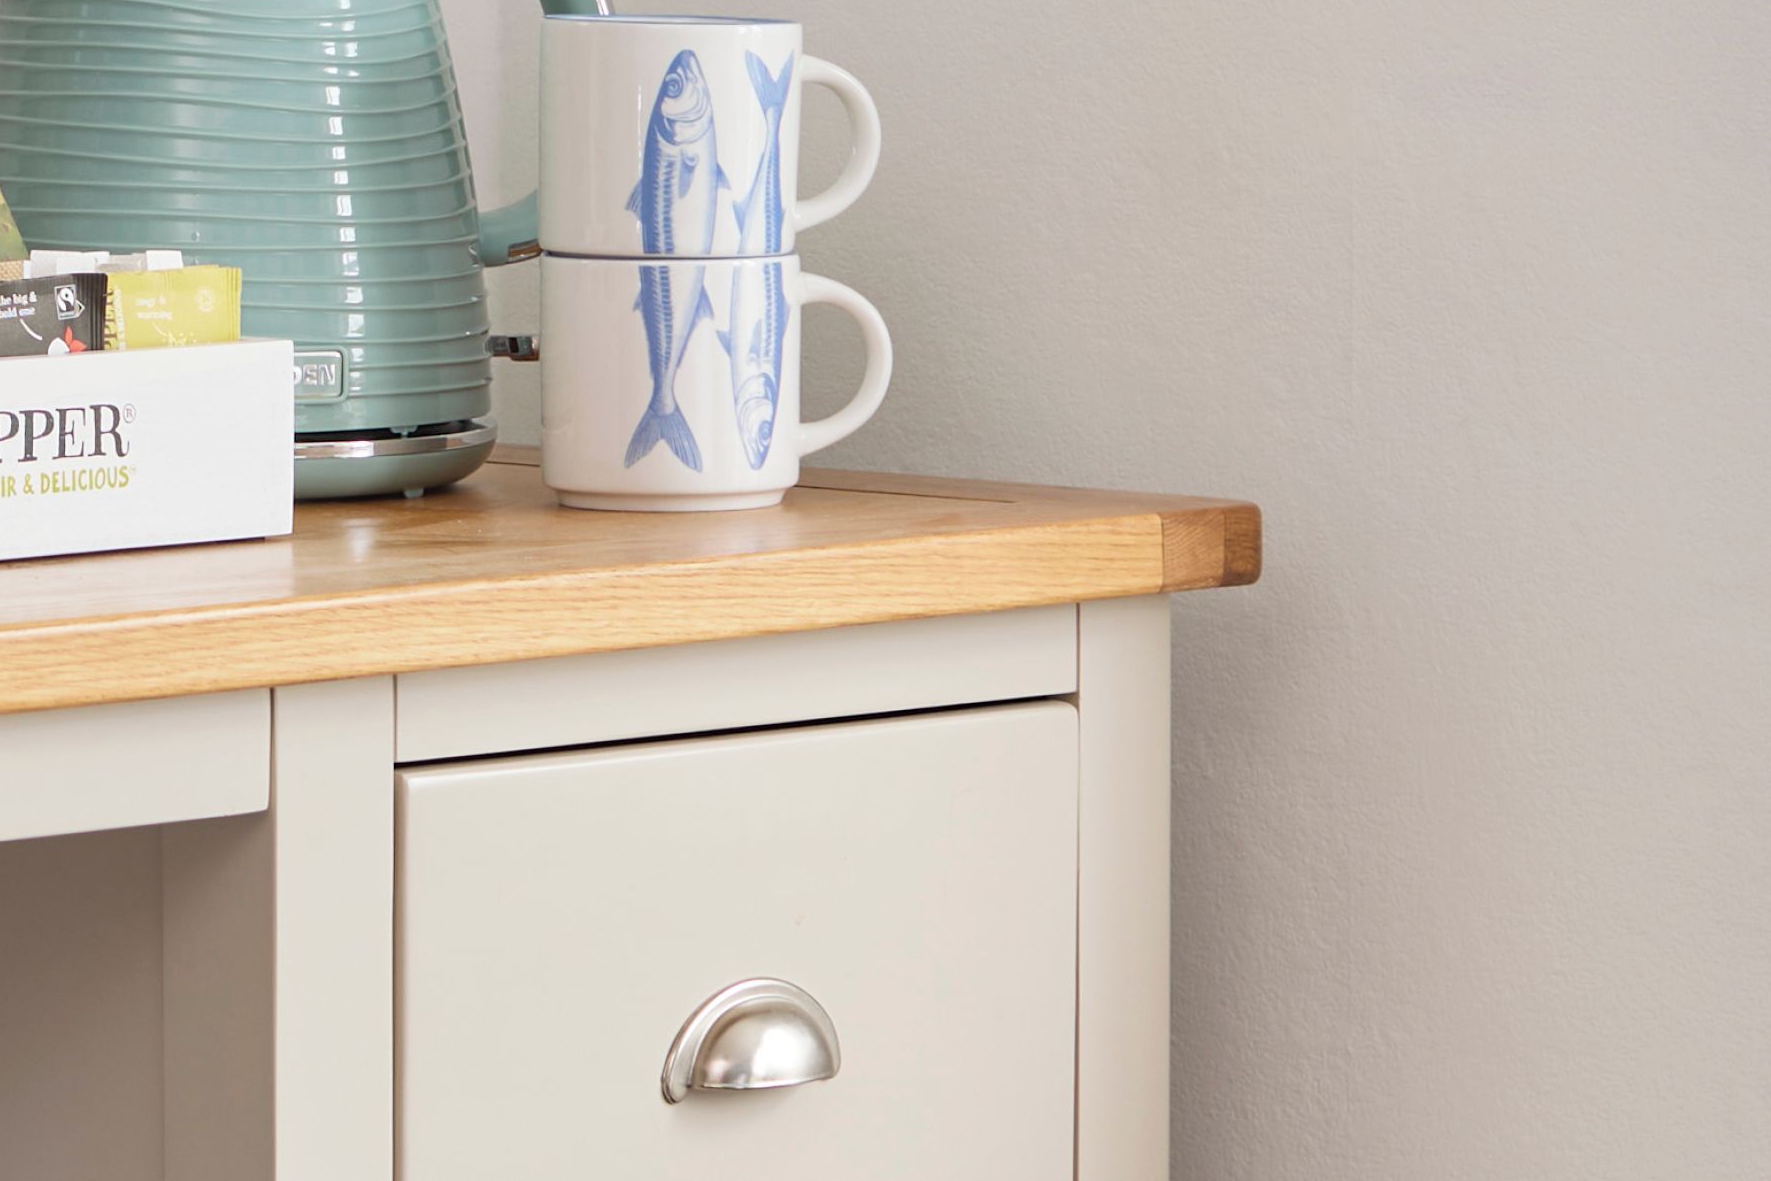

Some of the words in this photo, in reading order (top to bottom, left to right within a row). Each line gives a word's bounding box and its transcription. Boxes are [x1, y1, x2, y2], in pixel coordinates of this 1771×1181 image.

[12, 293, 28, 306] big
[29, 291, 37, 302] &
[23, 473, 34, 495] &
